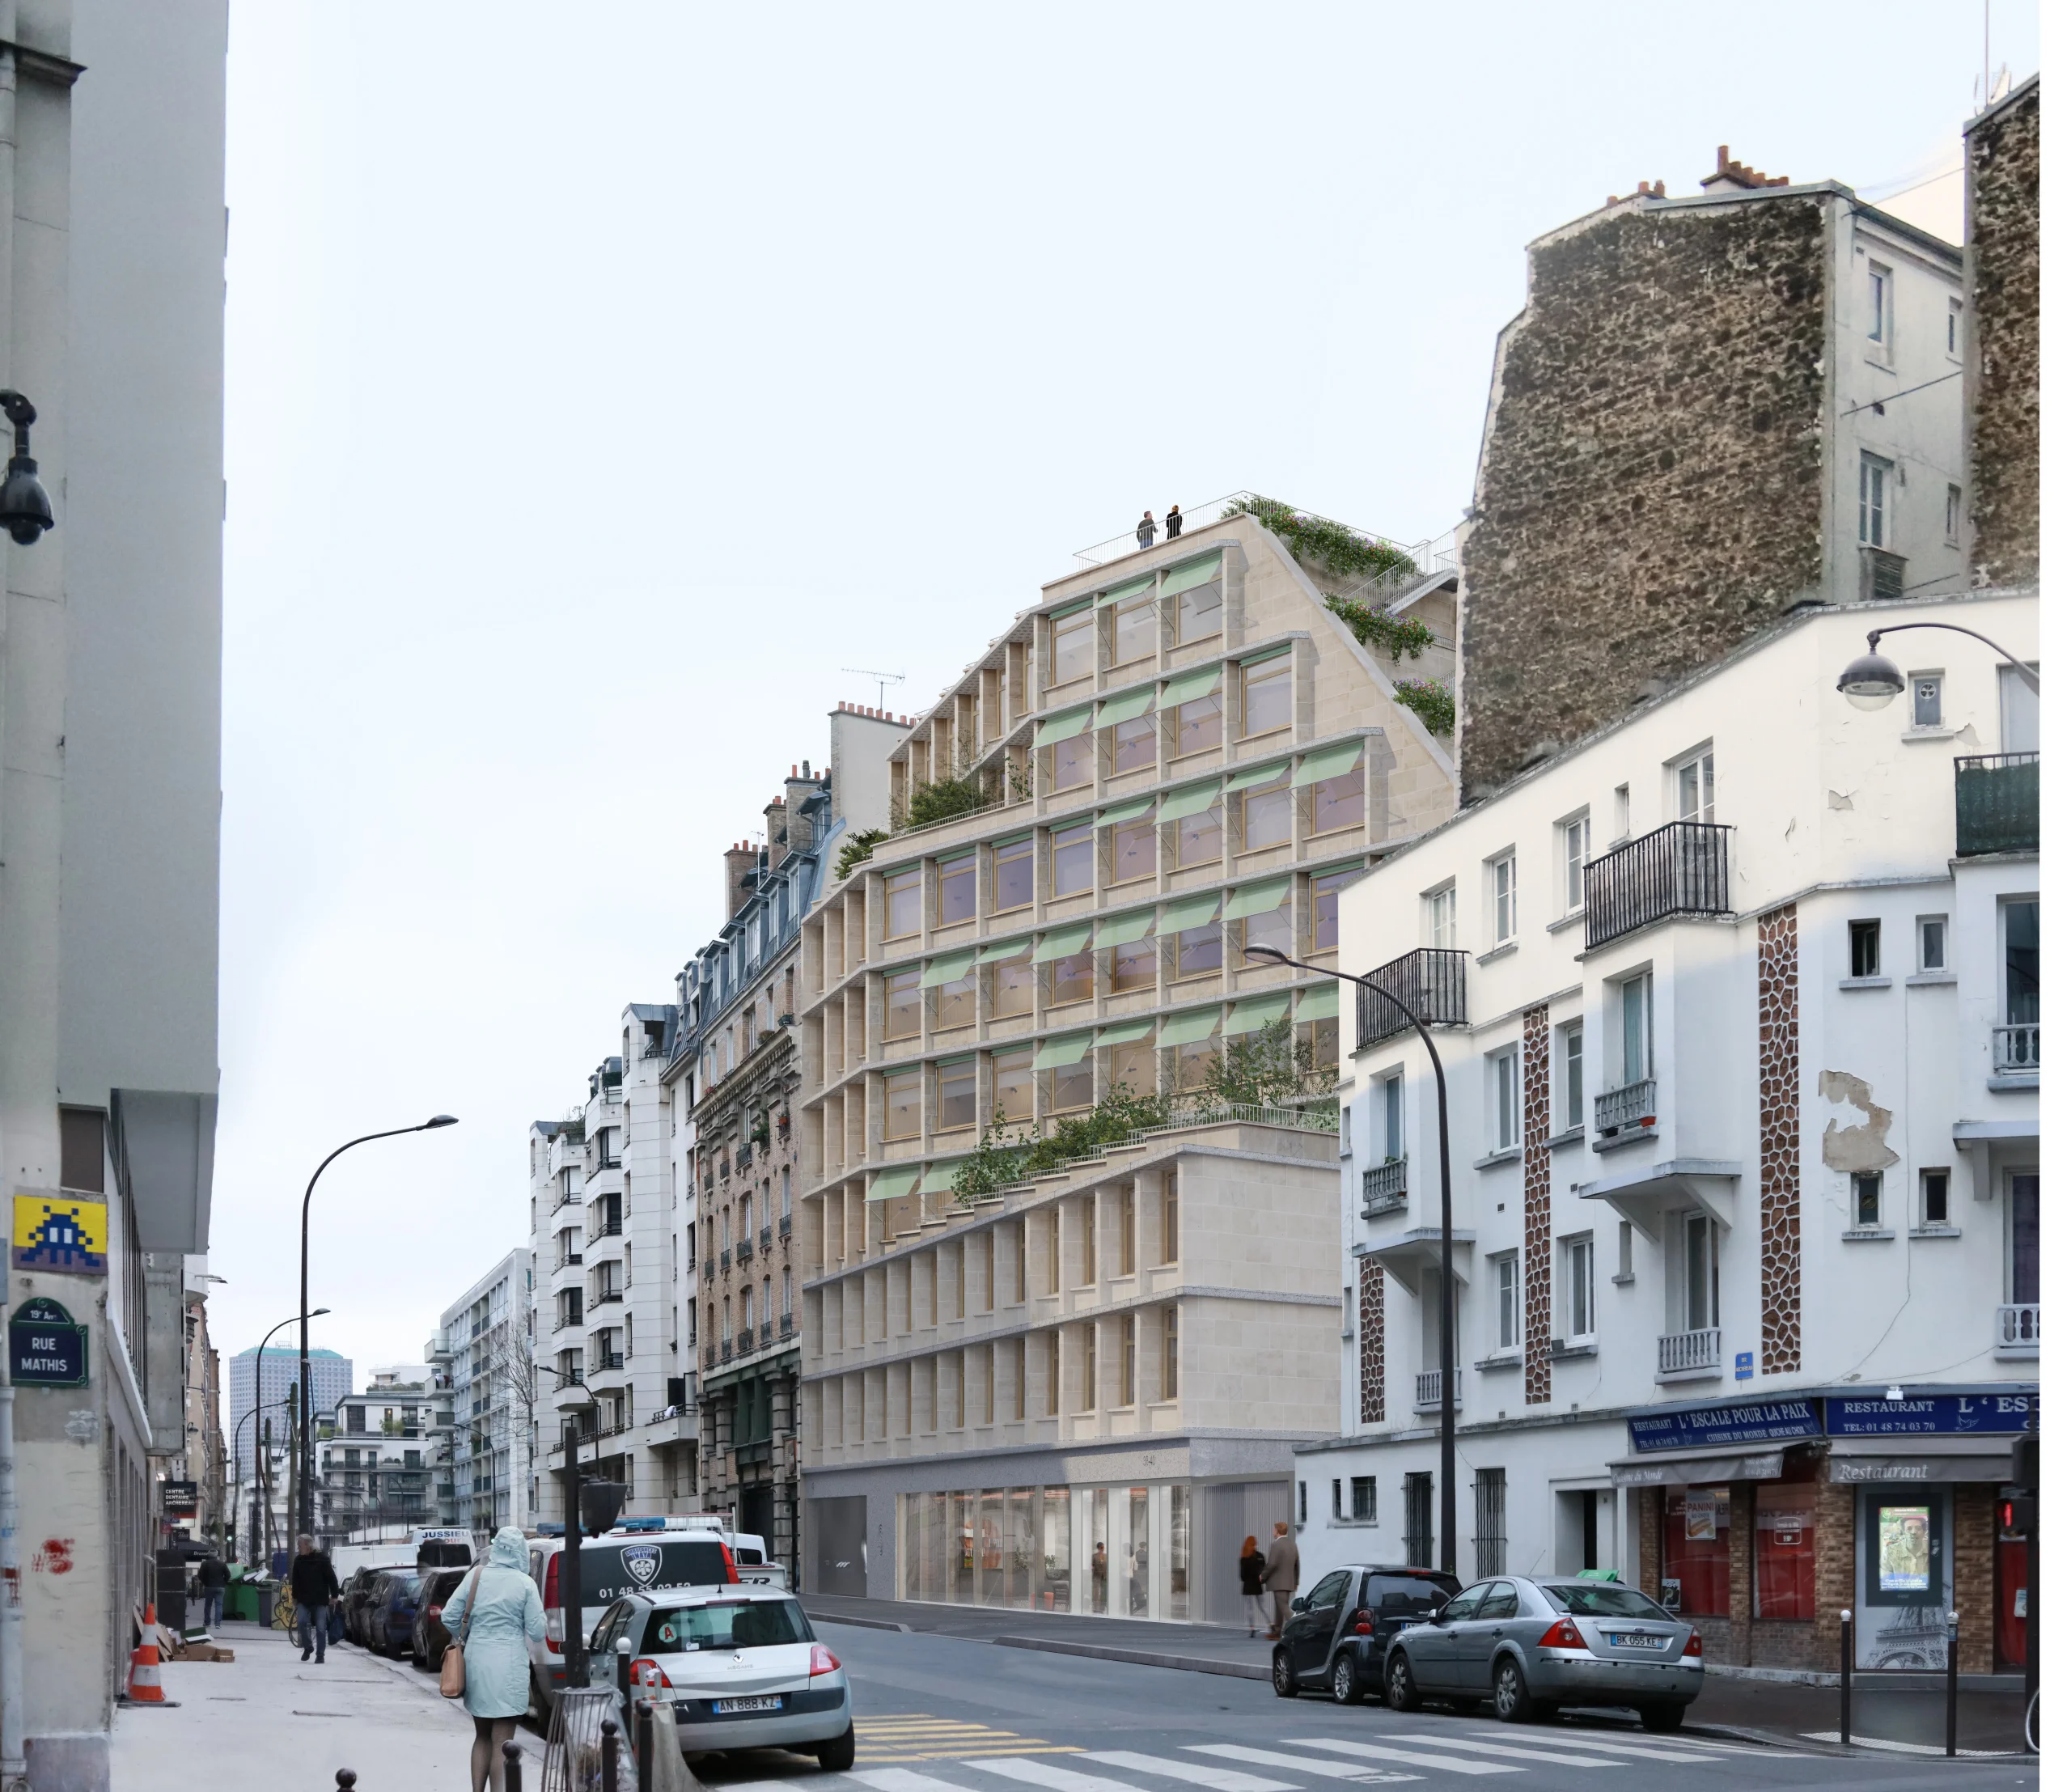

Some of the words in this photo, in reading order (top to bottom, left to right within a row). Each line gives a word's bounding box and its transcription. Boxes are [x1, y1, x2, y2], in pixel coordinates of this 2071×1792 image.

[32, 1337, 57, 1350] RUE
[21, 1358, 68, 1372] MATHIS
[1844, 1401, 1935, 1413] RESTAURANT
[1633, 1419, 1672, 1431] RESTAURANT
[1732, 1407, 1763, 1424] POUR
[1764, 1406, 1781, 1421] LA
[1782, 1402, 1811, 1419] PAIX
[1866, 1423, 1877, 1431] 01
[1880, 1423, 1892, 1431] 48
[1895, 1423, 1906, 1431] 74
[1909, 1422, 1921, 1431] 03
[1924, 1422, 1935, 1431] 70
[1706, 1433, 1732, 1442] CUISINE
[1733, 1432, 1743, 1440] DU
[1743, 1430, 1768, 1439] MONDE
[1838, 1464, 1929, 1480] Restaurant
[1688, 1502, 1714, 1512] PANINI
[599, 1588, 613, 1599] 01
[618, 1587, 634, 1596] 48
[664, 1626, 674, 1640] A
